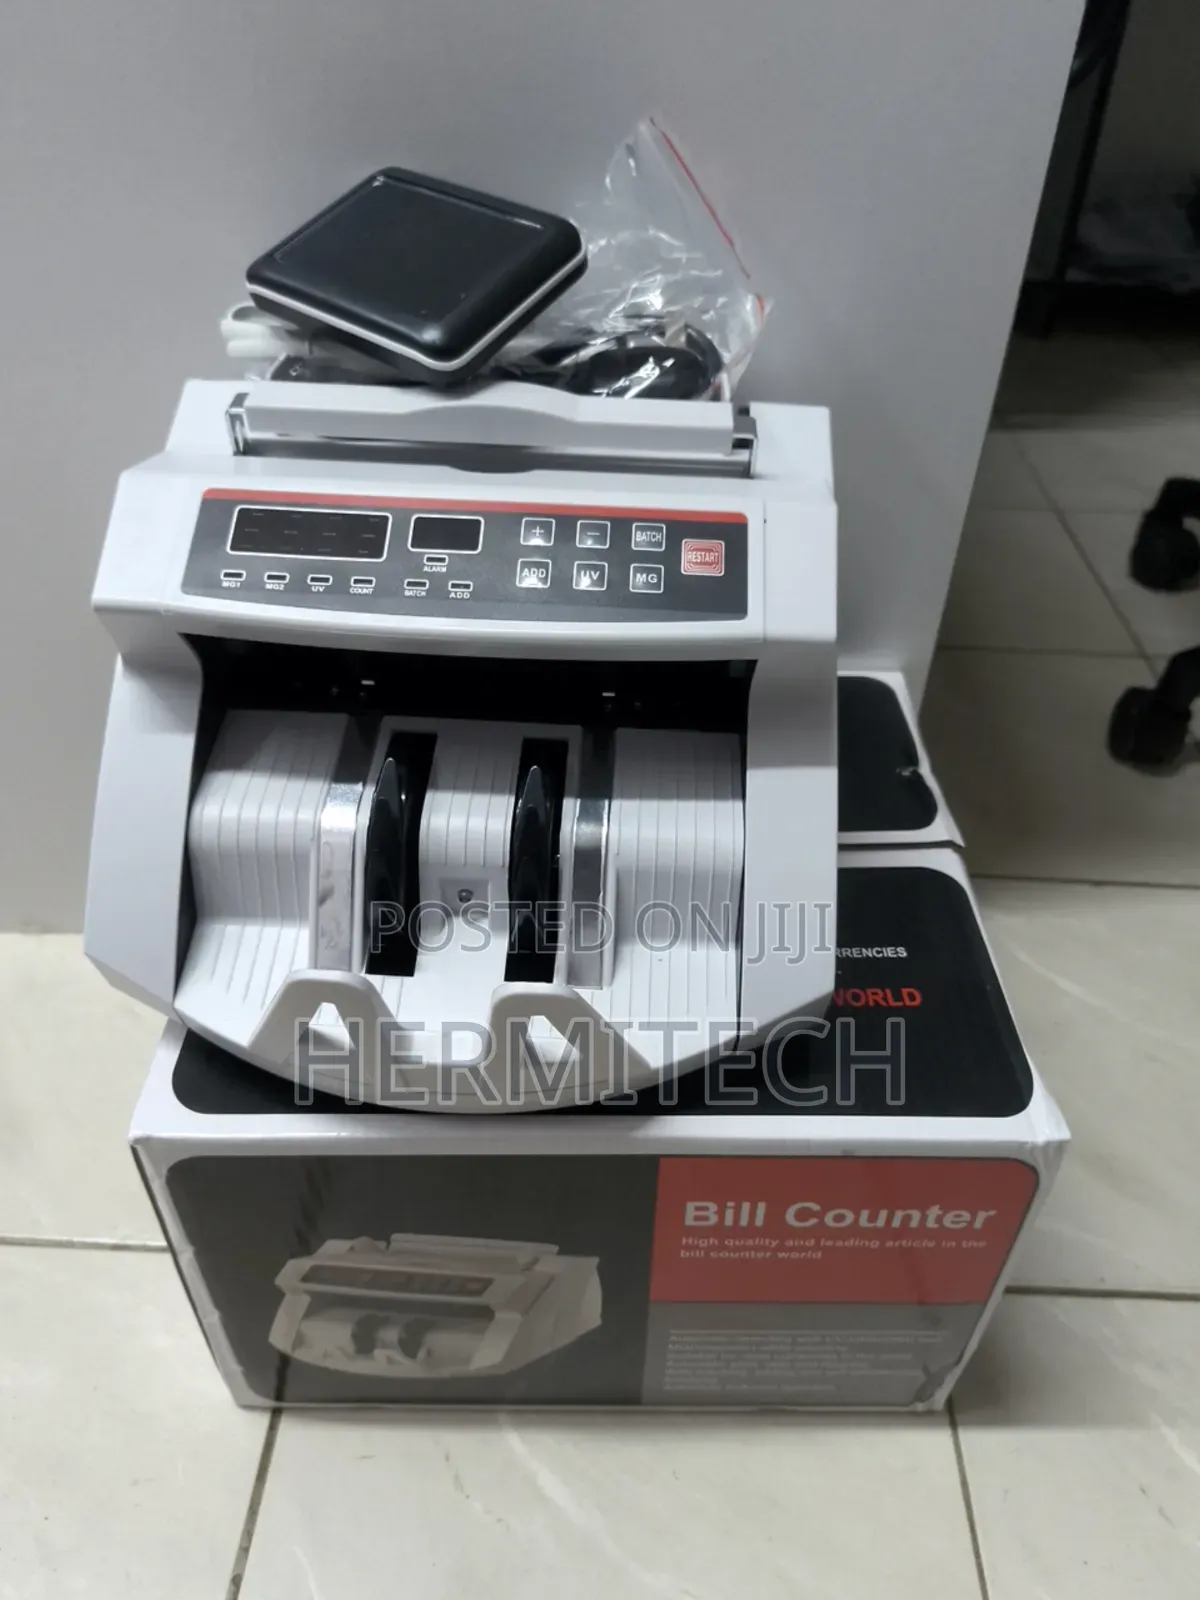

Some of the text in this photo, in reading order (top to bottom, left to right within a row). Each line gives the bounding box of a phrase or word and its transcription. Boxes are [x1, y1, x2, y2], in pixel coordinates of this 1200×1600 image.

[635, 530, 662, 543] BATCH
[687, 551, 719, 564] RESTART
[423, 564, 447, 573] ALARM
[521, 567, 546, 579] ADD
[579, 570, 600, 581] UV
[635, 573, 657, 585] MG
[221, 580, 241, 589] MG1
[265, 583, 285, 591] MG2
[349, 586, 374, 595] COUNT
[404, 589, 427, 597] BATCH
[684, 1200, 997, 1230] Bill Counter
[682, 1236, 718, 1248] High
[724, 1237, 780, 1248] quality
[820, 1237, 880, 1249] leading
[680, 1249, 823, 1260] bill counter world
